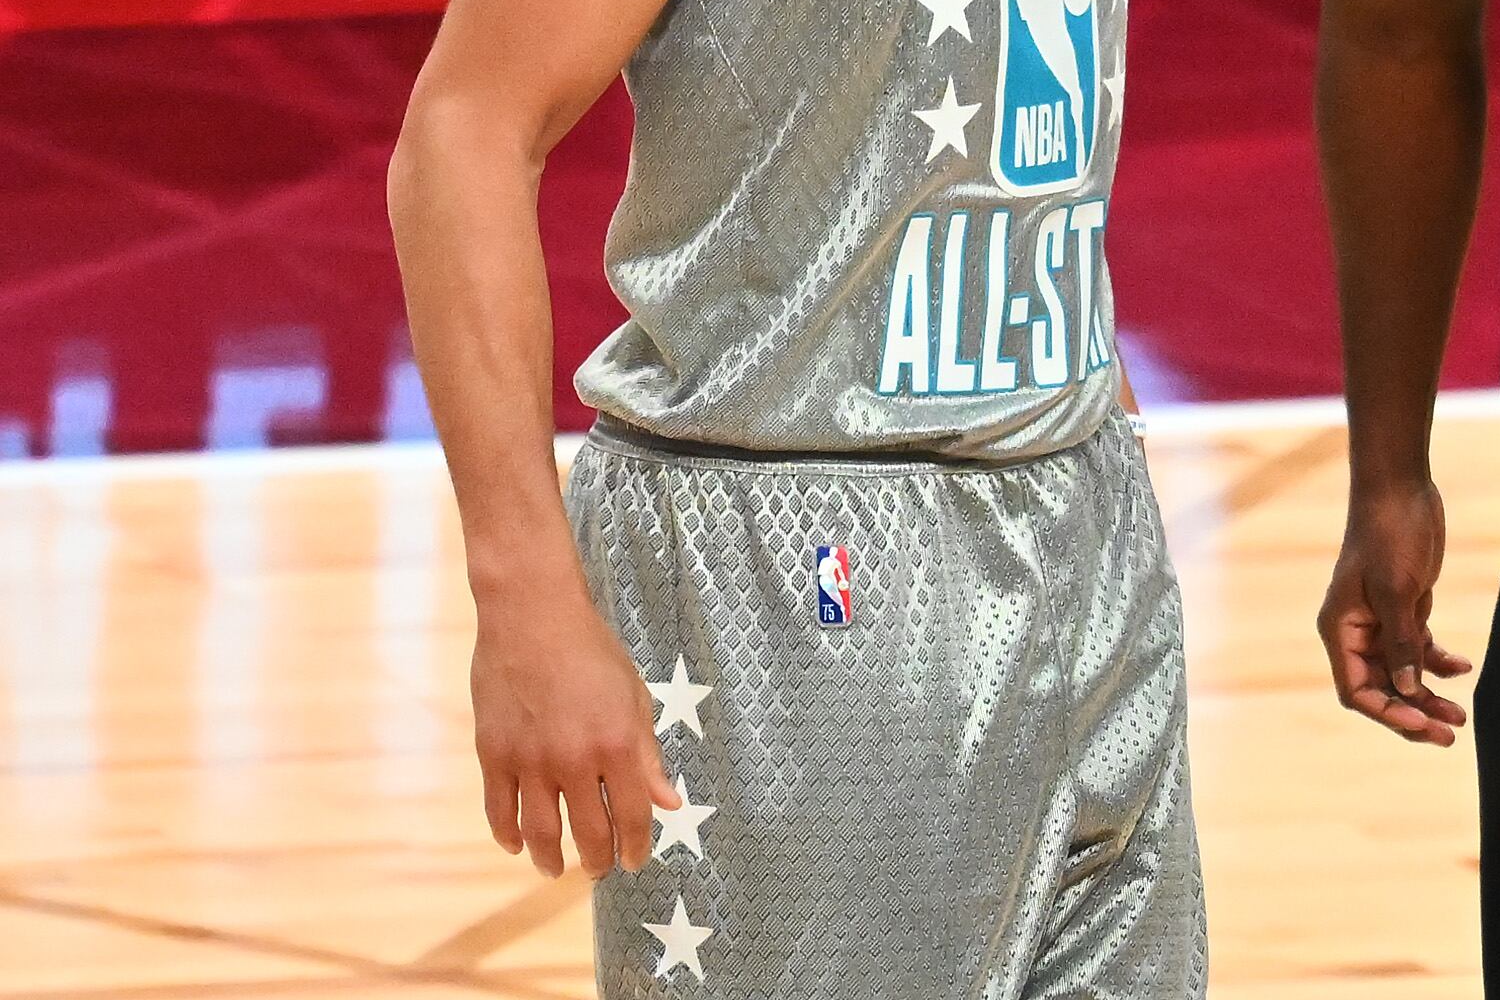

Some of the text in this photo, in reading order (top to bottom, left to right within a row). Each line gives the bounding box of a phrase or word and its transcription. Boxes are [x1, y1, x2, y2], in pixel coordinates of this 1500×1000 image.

[1013, 100, 1067, 168] NBA
[877, 197, 1111, 396] ALL-ST
[821, 603, 836, 622] 75
